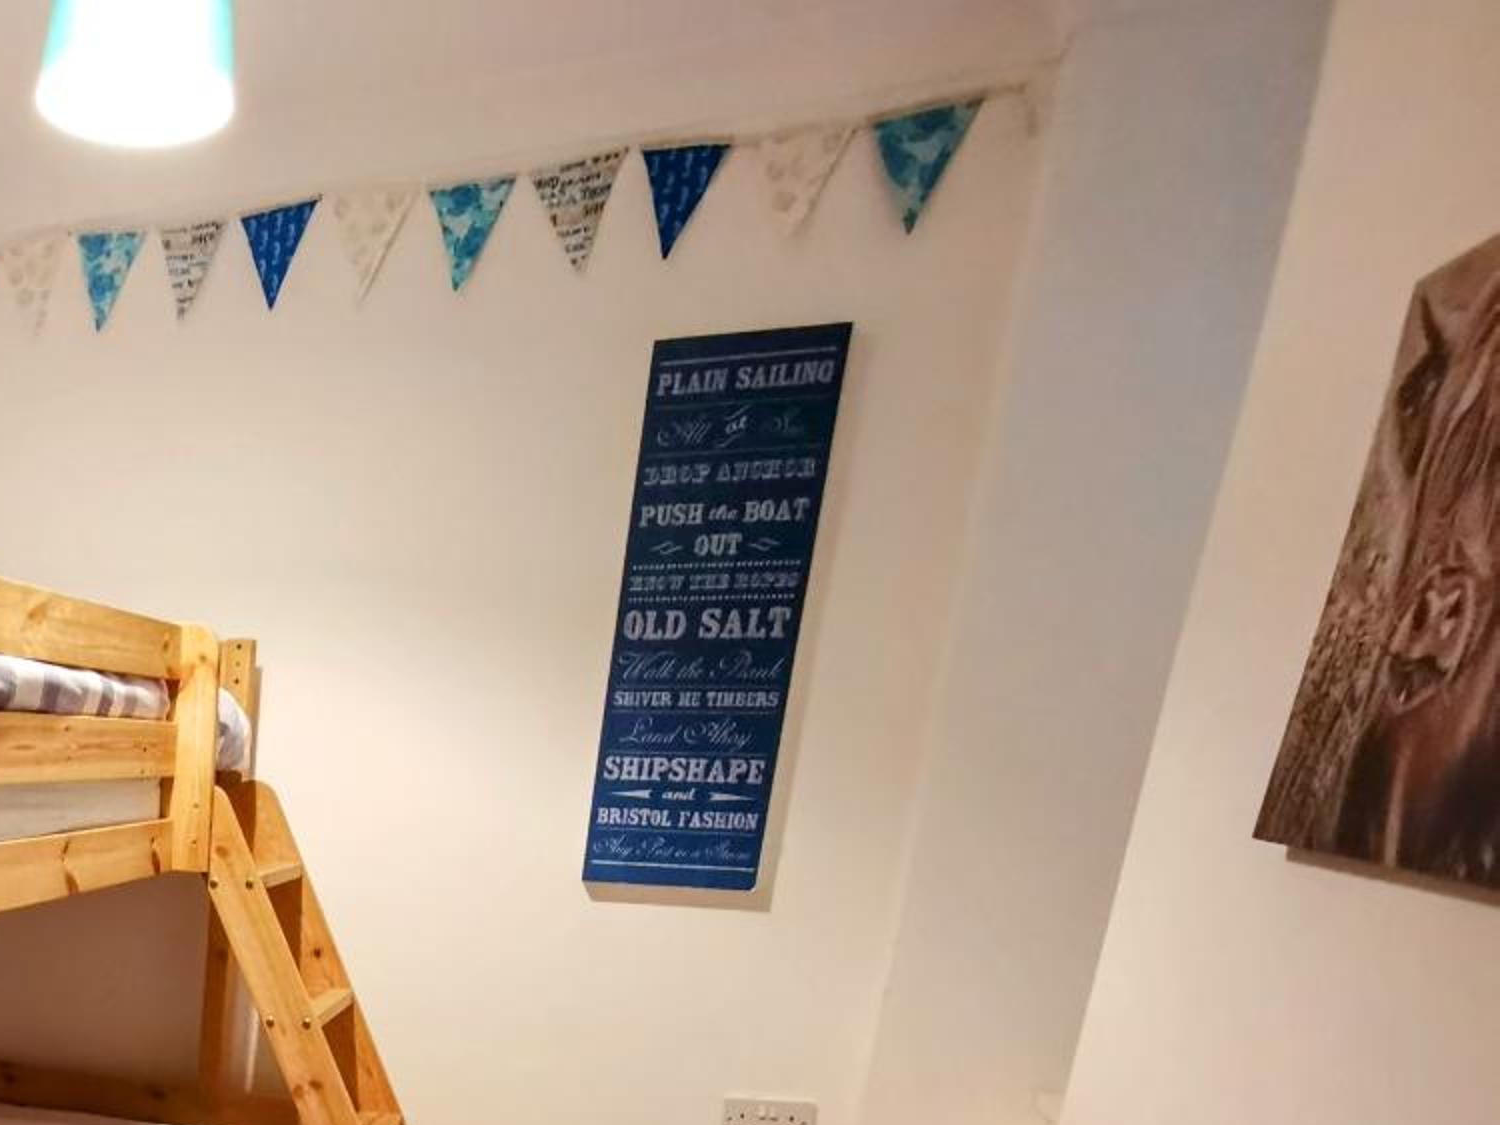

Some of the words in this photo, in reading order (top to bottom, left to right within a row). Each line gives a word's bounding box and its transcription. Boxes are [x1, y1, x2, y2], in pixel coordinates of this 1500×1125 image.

[656, 368, 728, 396] PLAIN
[735, 360, 835, 390] SAILING
[638, 503, 705, 527] PUSH
[708, 507, 739, 521] the
[742, 498, 810, 523] BOAT
[693, 533, 743, 556] OUT
[623, 609, 687, 640] OLD
[699, 606, 791, 639] SALT
[613, 690, 671, 707] SHIVER
[677, 691, 700, 707] ME
[706, 690, 781, 707] TIMBERS
[603, 755, 767, 785] SHIPSHAPE
[662, 787, 697, 800] and
[596, 807, 671, 827] BRISTOL
[678, 811, 759, 830] FASHION
